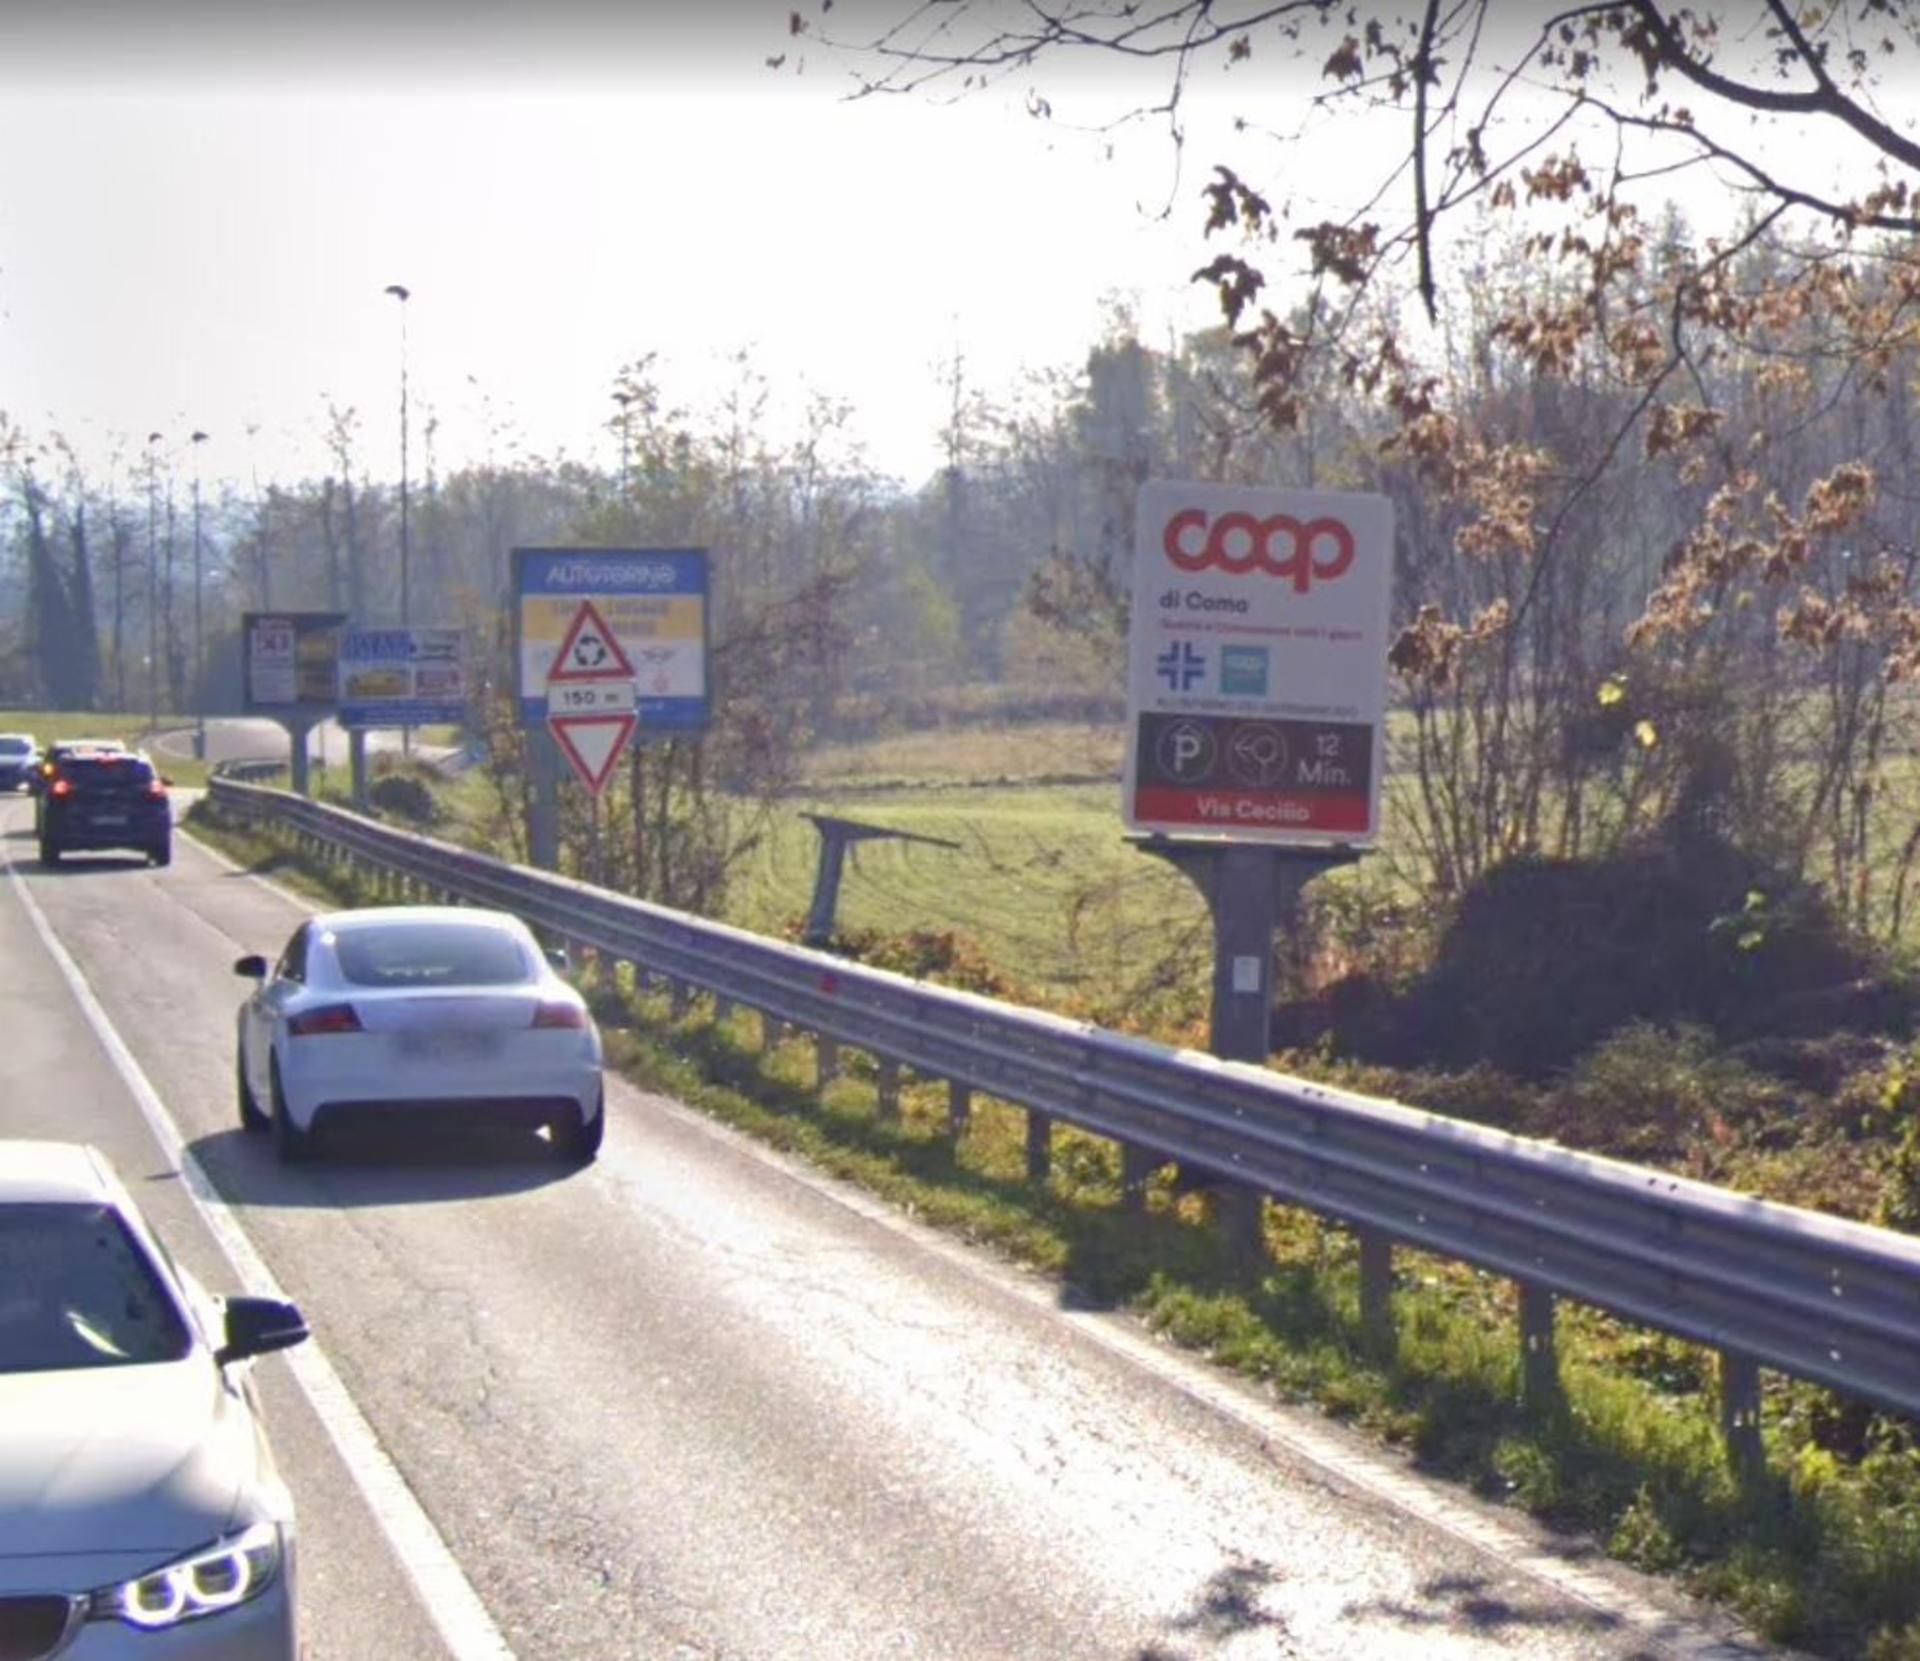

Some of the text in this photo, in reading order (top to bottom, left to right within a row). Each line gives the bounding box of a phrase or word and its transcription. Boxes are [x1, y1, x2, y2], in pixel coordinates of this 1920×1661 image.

[1163, 508, 1355, 594] coop
[1159, 588, 1250, 613] di Como
[563, 690, 596, 705] 150
[1315, 733, 1339, 757] 12
[1297, 760, 1352, 787] Min.
[1196, 795, 1231, 817] Via
